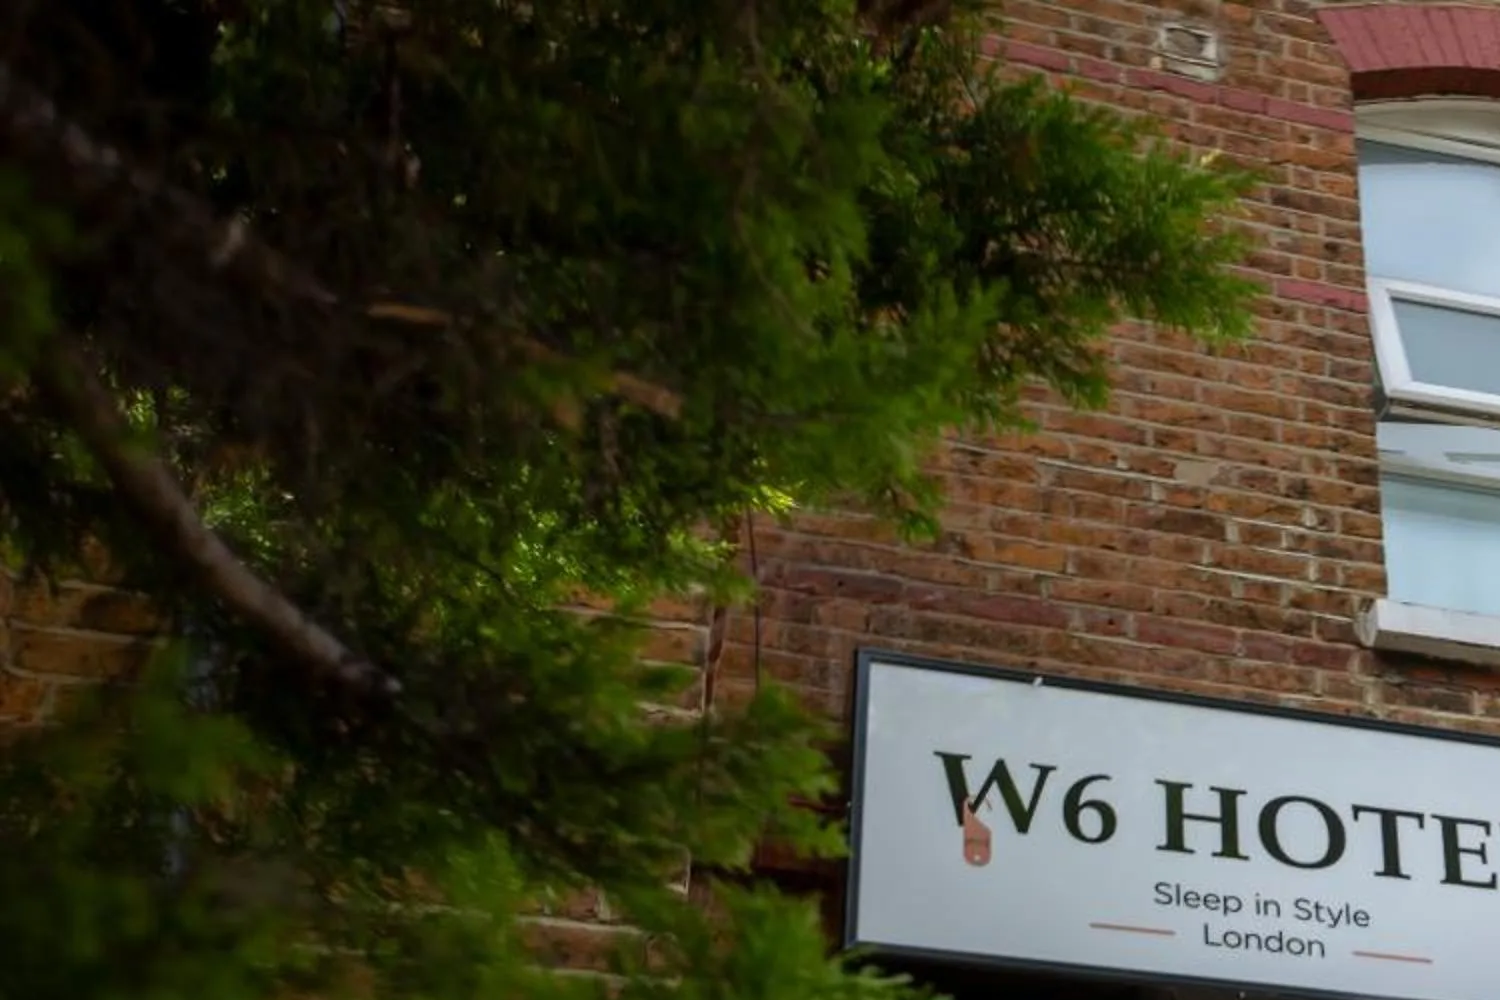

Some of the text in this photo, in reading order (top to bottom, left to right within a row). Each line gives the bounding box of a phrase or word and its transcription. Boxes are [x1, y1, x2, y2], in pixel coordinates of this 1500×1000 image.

[933, 750, 1118, 845] W6
[1153, 881, 1371, 929] Sleep in Style
[1203, 922, 1326, 958] London
